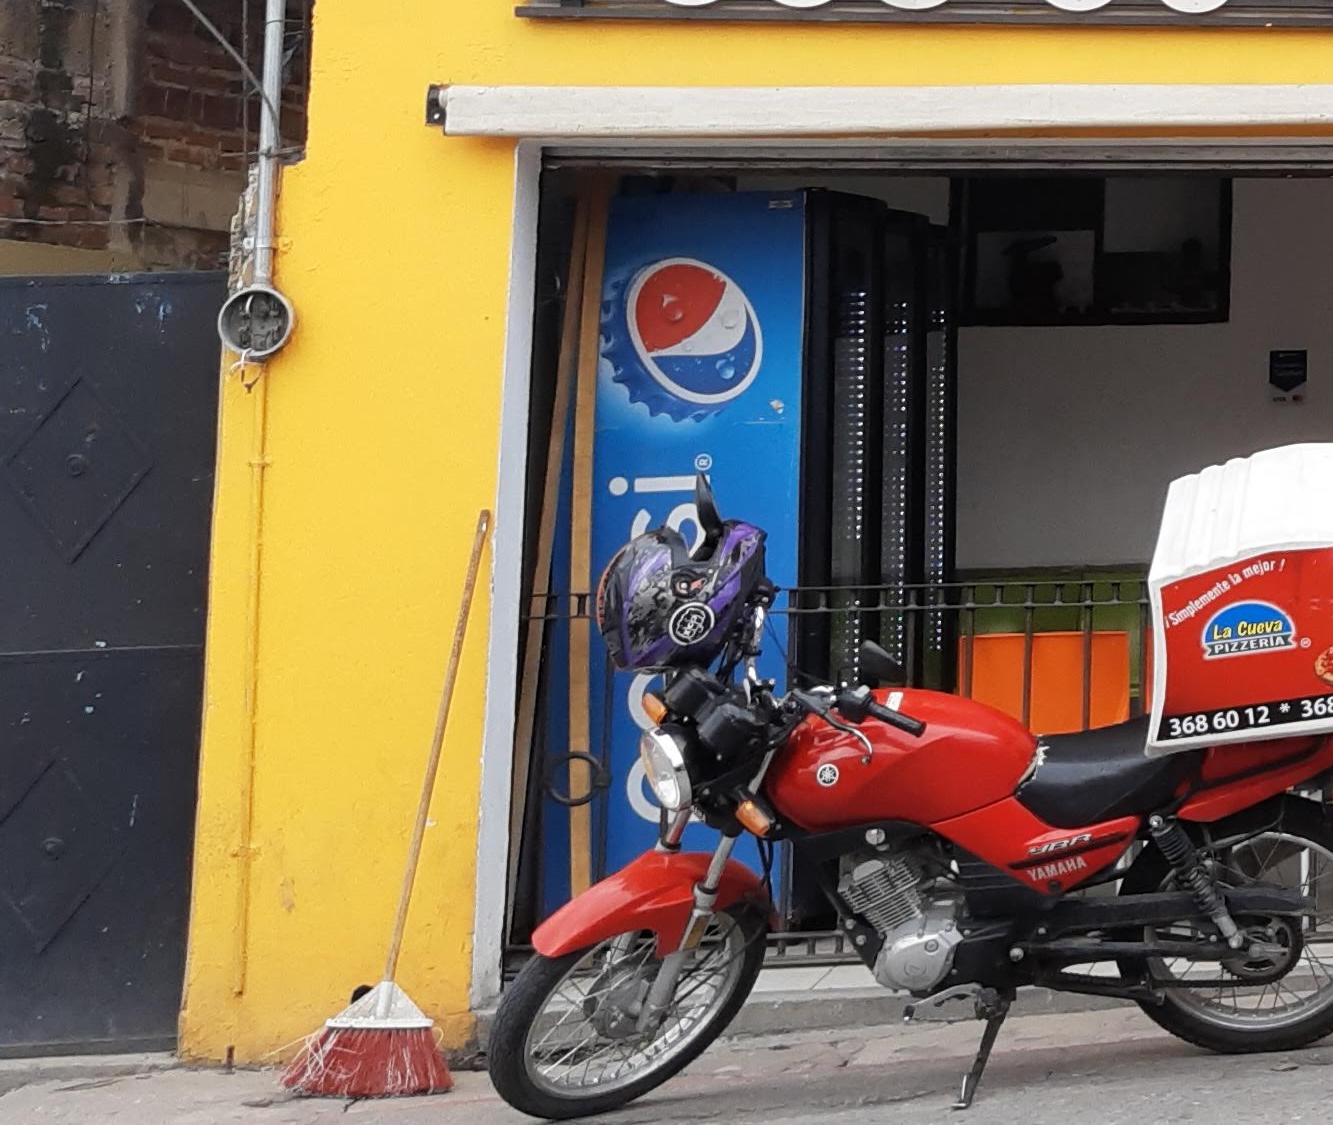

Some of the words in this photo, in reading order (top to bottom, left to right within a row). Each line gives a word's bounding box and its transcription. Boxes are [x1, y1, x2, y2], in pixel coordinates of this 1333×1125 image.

[1213, 624, 1232, 640] La
[1237, 619, 1283, 636] Cueva
[1169, 715, 1209, 736] 368
[1212, 710, 1240, 731] 60
[1244, 706, 1271, 725] 12
[1027, 855, 1087, 882] YAMAHA
